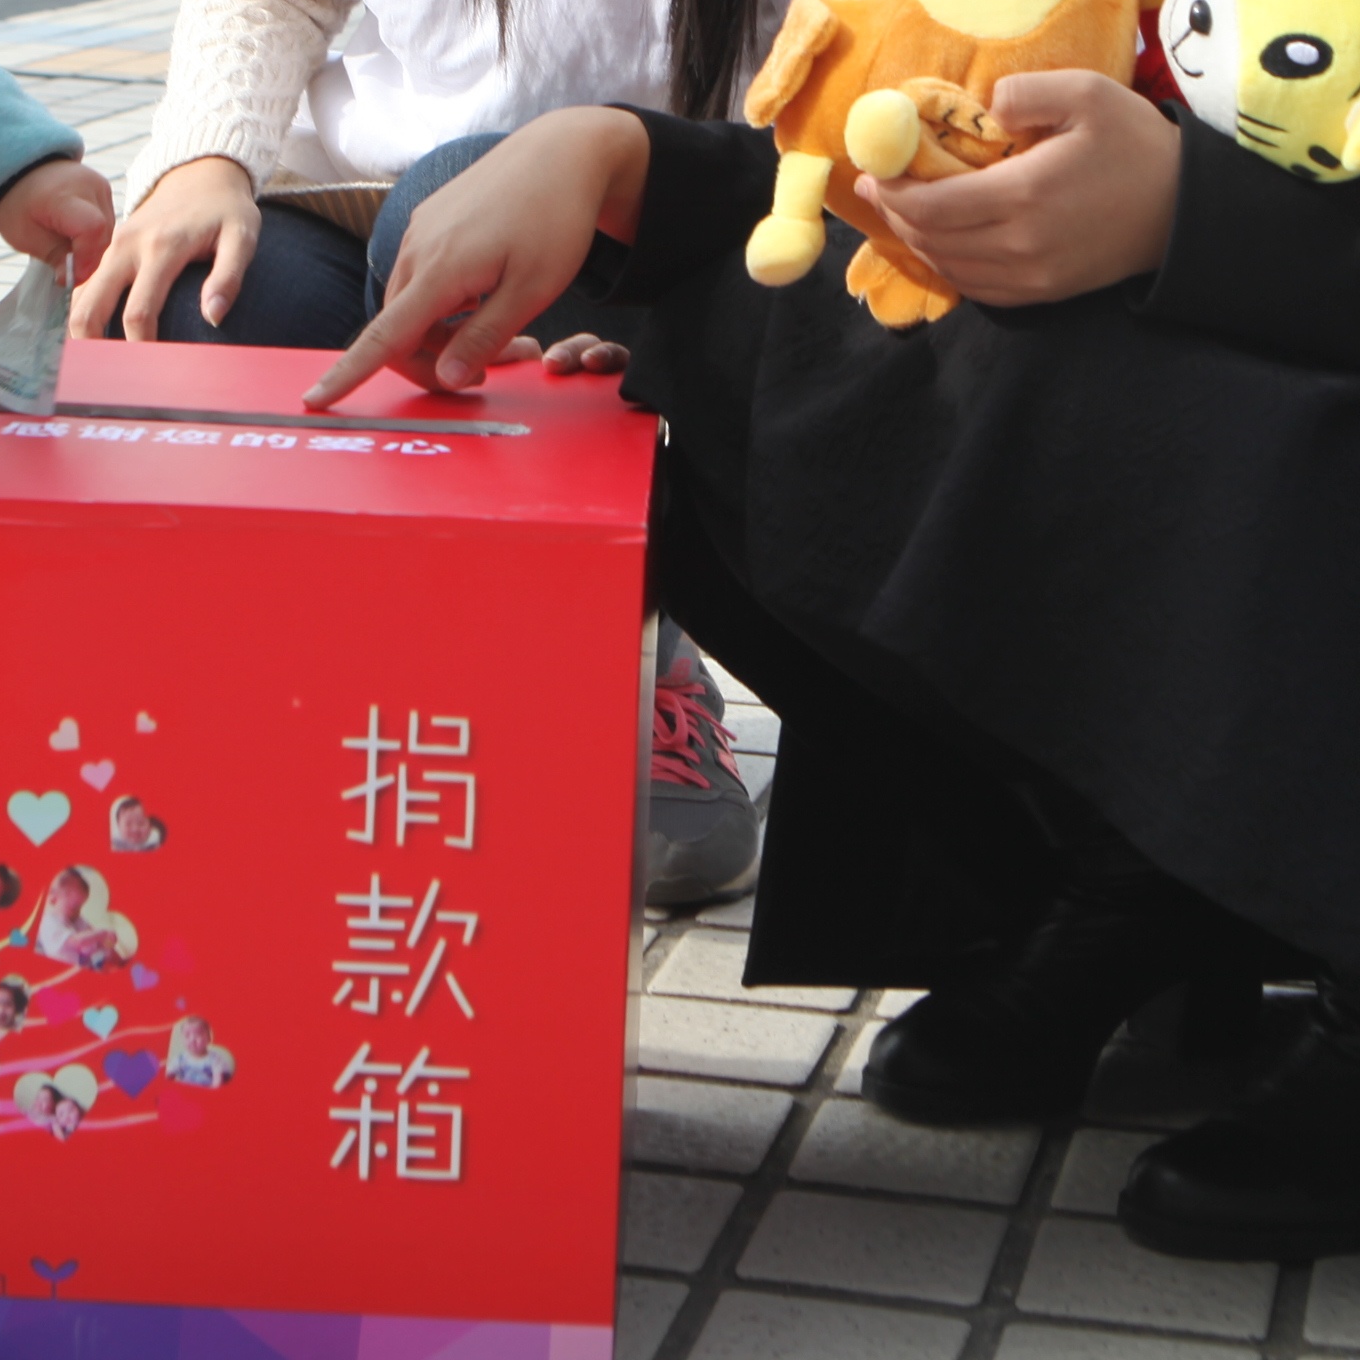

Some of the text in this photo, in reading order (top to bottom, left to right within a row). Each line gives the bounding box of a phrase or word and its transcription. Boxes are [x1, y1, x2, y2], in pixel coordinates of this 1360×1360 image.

[0, 421, 452, 456] 感谢您的爱心
[329, 703, 478, 1183] 捐款箱
